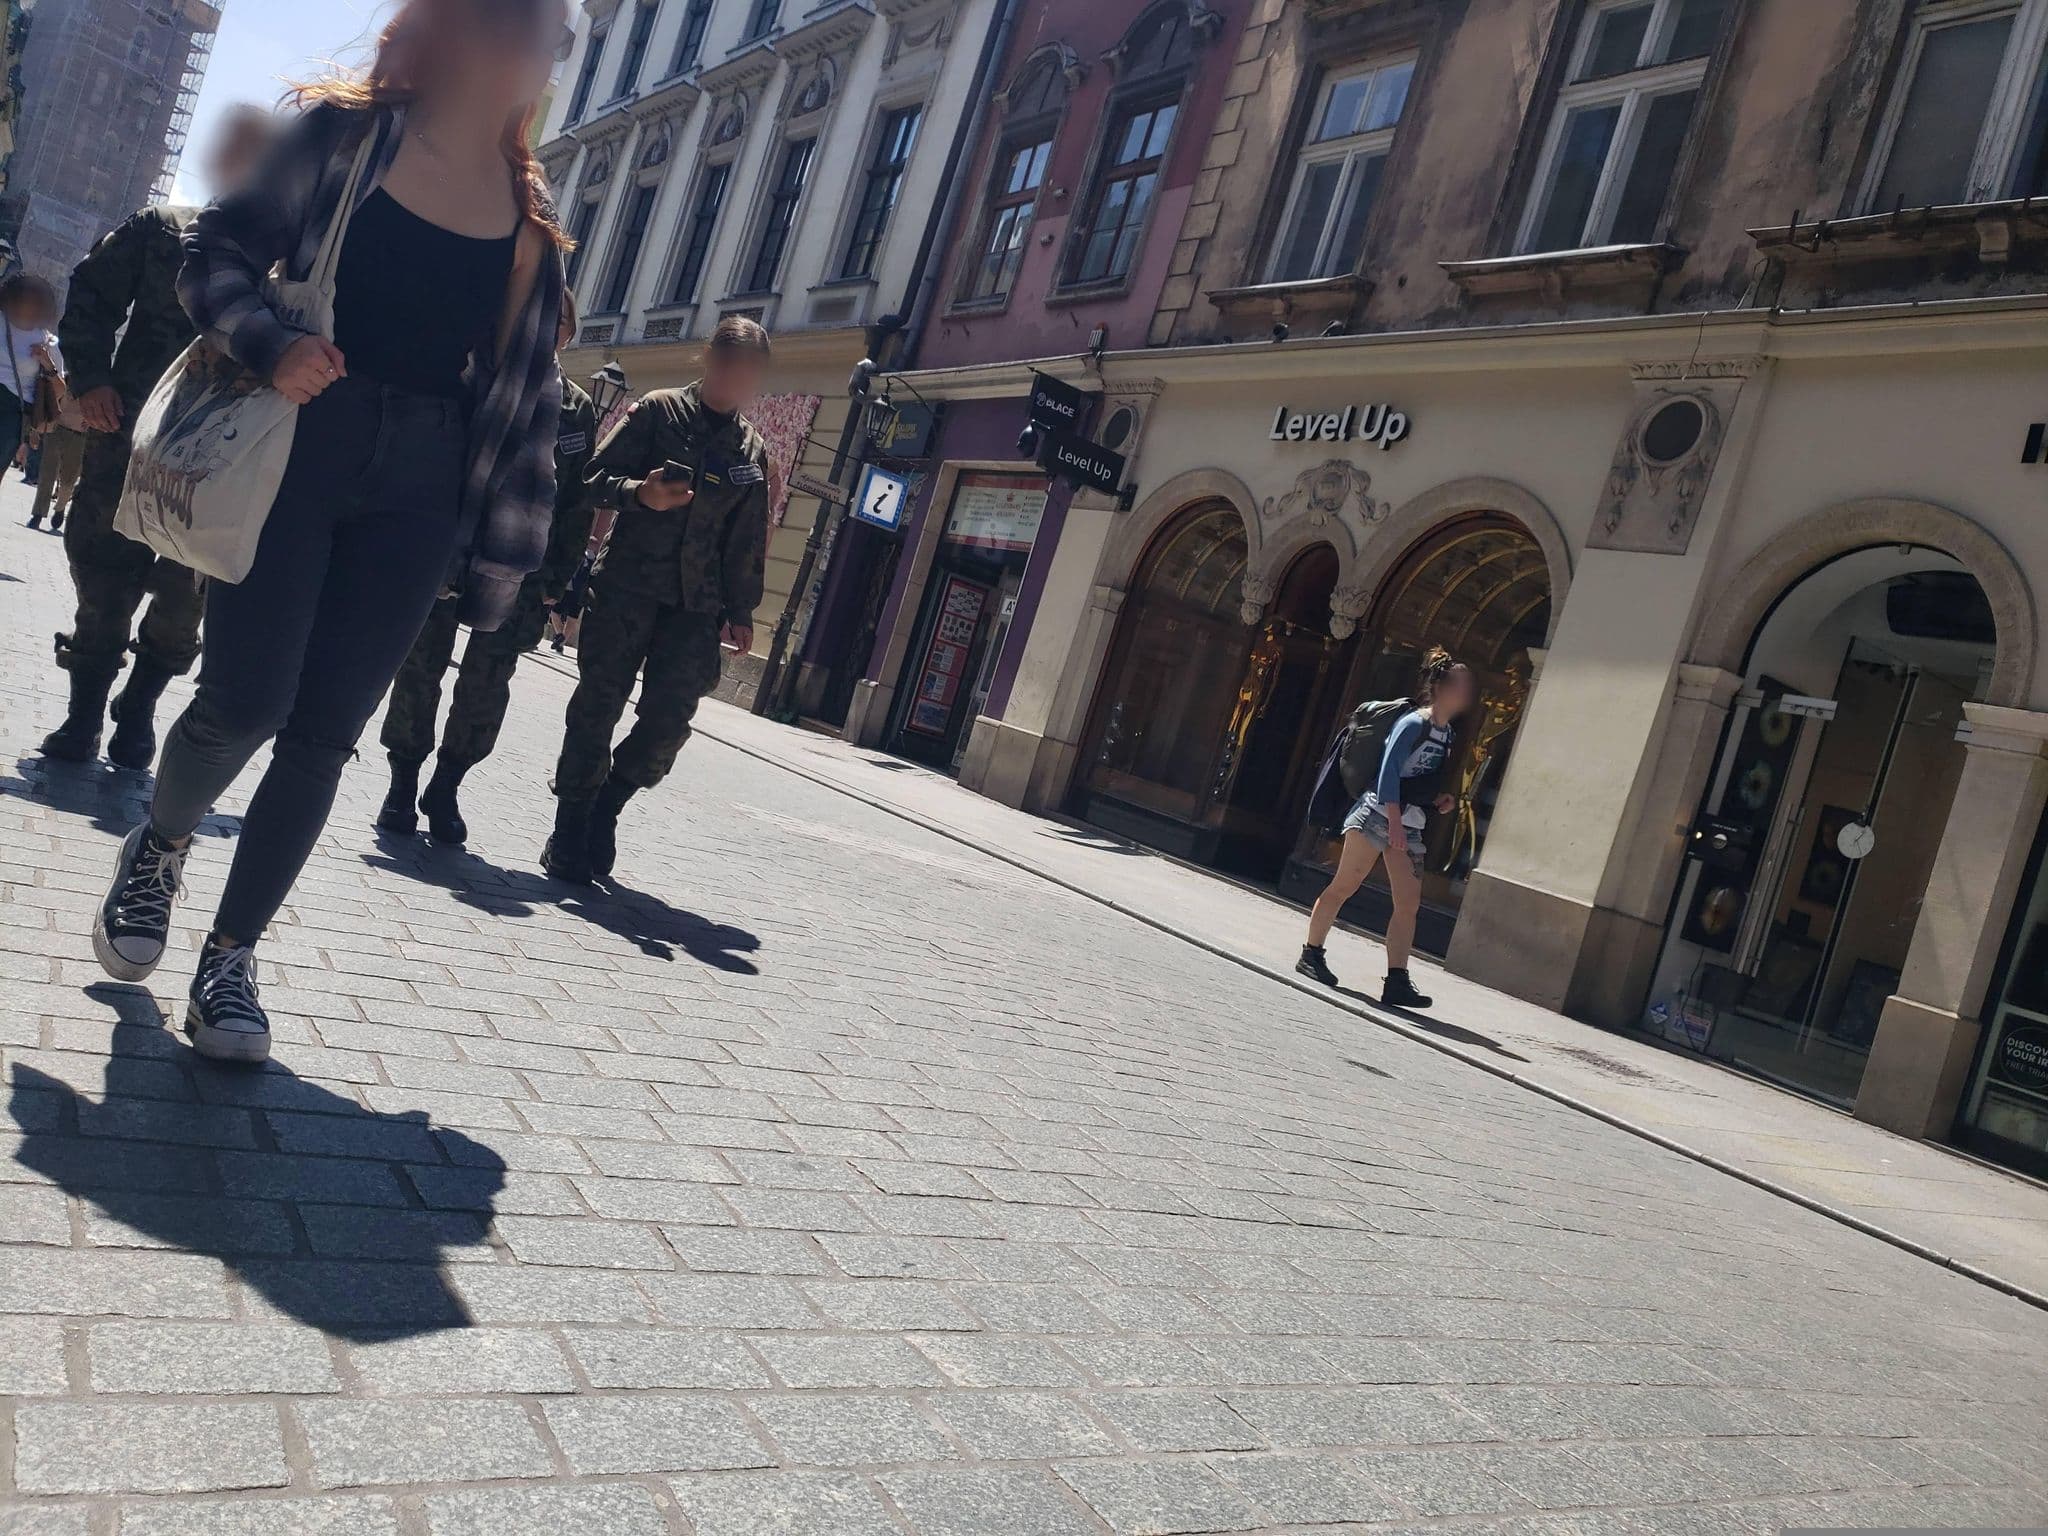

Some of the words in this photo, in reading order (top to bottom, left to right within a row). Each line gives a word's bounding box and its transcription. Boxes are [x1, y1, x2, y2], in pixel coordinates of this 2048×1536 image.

[1269, 404, 1354, 441] Level
[1358, 403, 1409, 450] Up
[1057, 446, 1091, 471] Level
[1094, 461, 1111, 480] Up
[2007, 1046, 2036, 1063] YOUR
